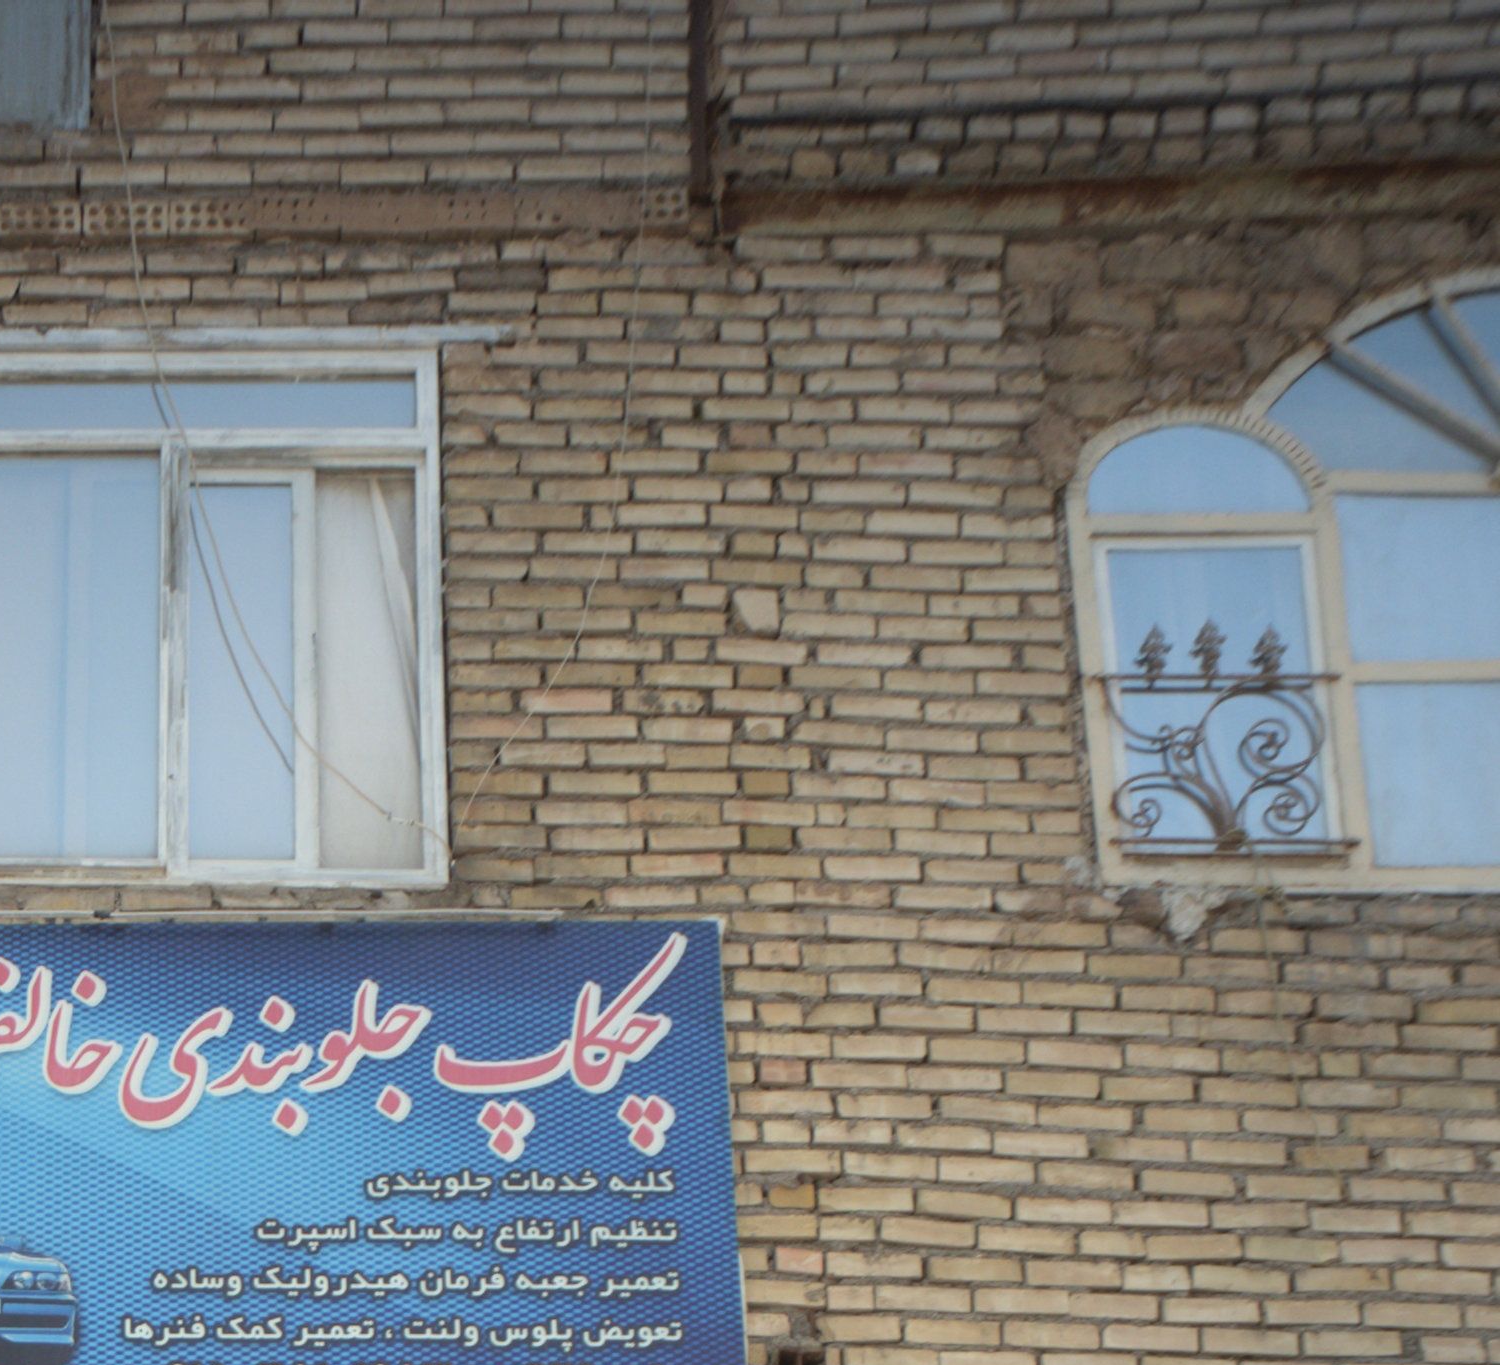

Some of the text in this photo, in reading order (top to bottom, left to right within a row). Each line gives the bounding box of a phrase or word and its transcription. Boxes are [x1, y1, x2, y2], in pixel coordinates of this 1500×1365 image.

[118, 978, 434, 1137] جلوبندی
[433, 931, 690, 1163] چکاپ
[366, 1169, 675, 1199] کلیه خدمات جلوبندی
[256, 1217, 678, 1253] تنظیم ارتفاع به سبک اسپرت
[152, 1265, 680, 1298] تعمیر جعبه فرمان هیدرولیک وساده
[123, 1314, 207, 1347] فنرها
[215, 1316, 283, 1340] کمک
[293, 1319, 375, 1347] تعمیر
[489, 1318, 573, 1353] پلوس
[582, 1319, 683, 1348] تعویض
